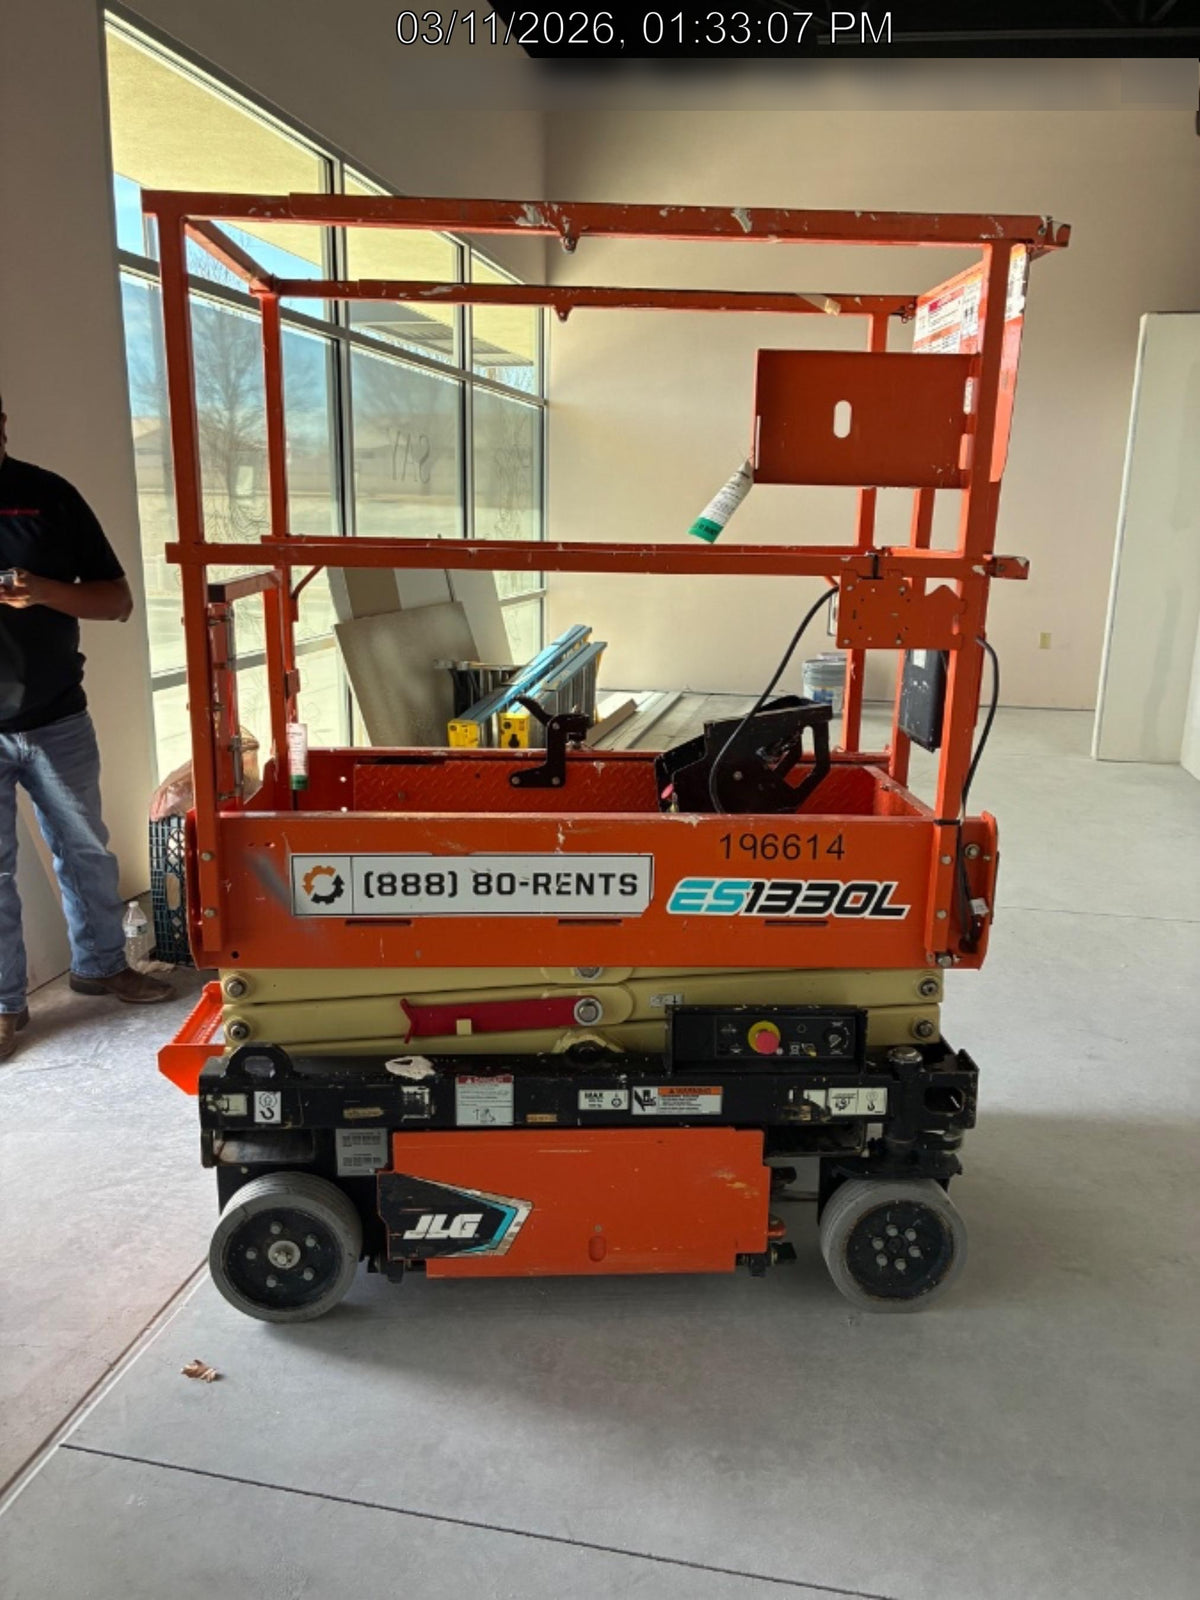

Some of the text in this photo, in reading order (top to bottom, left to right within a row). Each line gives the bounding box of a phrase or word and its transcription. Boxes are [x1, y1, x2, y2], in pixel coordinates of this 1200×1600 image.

[719, 833, 845, 860] 196614
[364, 870, 638, 899] (888) 80-RENTS
[668, 878, 908, 918] ES1330L
[402, 1213, 484, 1240] JLG
